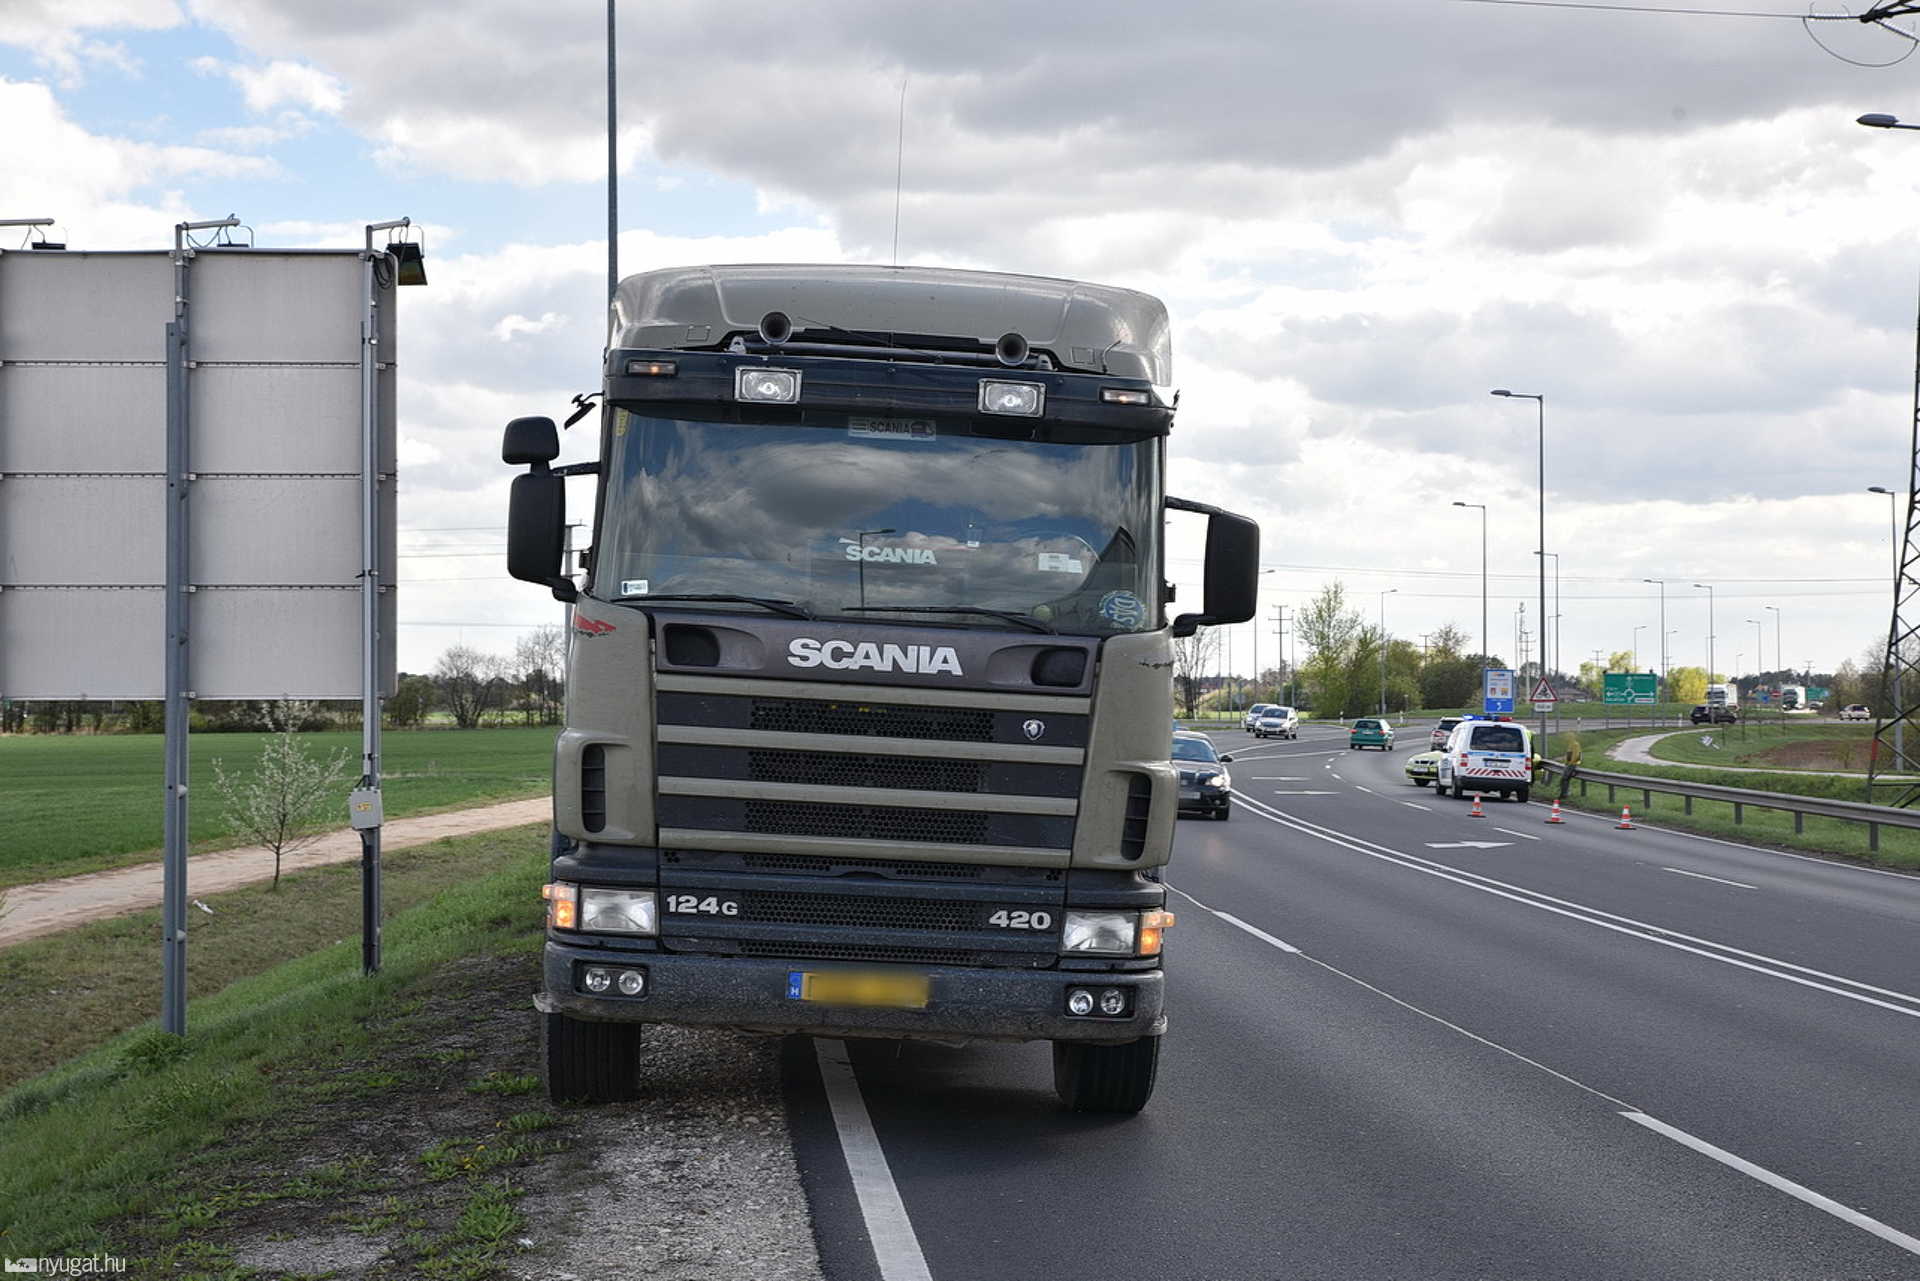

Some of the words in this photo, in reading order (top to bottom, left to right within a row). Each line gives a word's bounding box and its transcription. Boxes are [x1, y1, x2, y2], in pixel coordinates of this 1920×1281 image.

[868, 422, 910, 433] SCANIA
[846, 545, 937, 564] SCANIA
[787, 638, 964, 676] SCANIA
[667, 895, 740, 917] 124G
[989, 910, 1052, 930] 420
